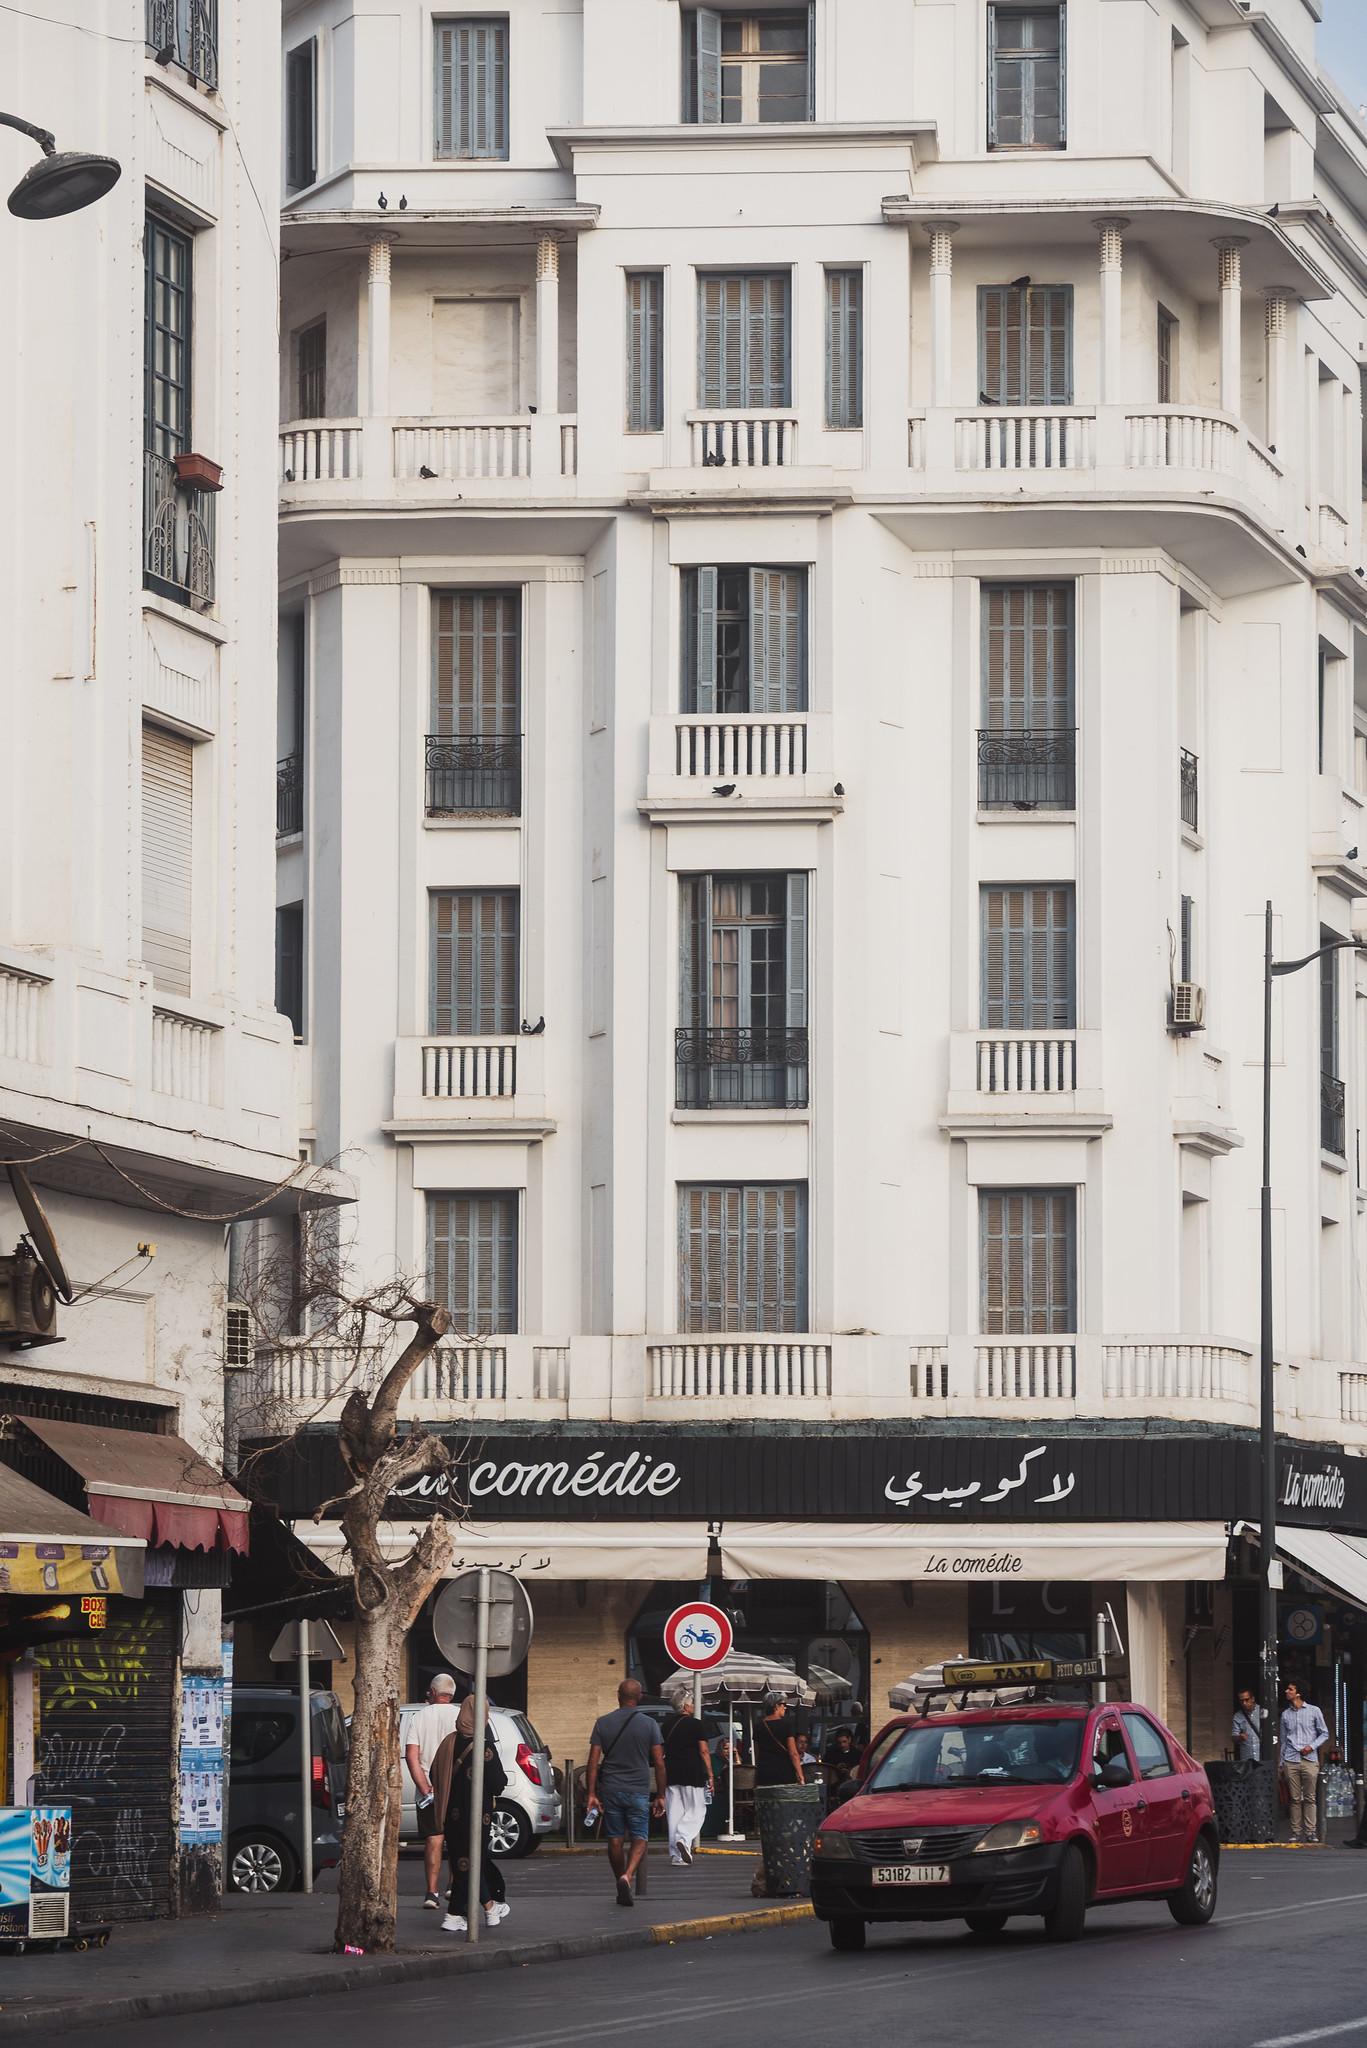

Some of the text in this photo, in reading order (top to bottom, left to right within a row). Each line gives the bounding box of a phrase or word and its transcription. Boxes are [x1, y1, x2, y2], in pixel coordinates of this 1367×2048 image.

[469, 1451, 681, 1497] comédie
[884, 1445, 1075, 1508] لا كوميدي
[1283, 1464, 1345, 1509] La comédie
[530, 1556, 551, 1571] لا
[923, 1553, 1023, 1574] La comédie
[993, 1666, 1037, 1680] TAXI
[1057, 1663, 1073, 1677] PETIT
[1083, 1661, 1097, 1675] TAXI
[878, 1867, 911, 1882] 53182
[938, 1866, 946, 1881] 7
